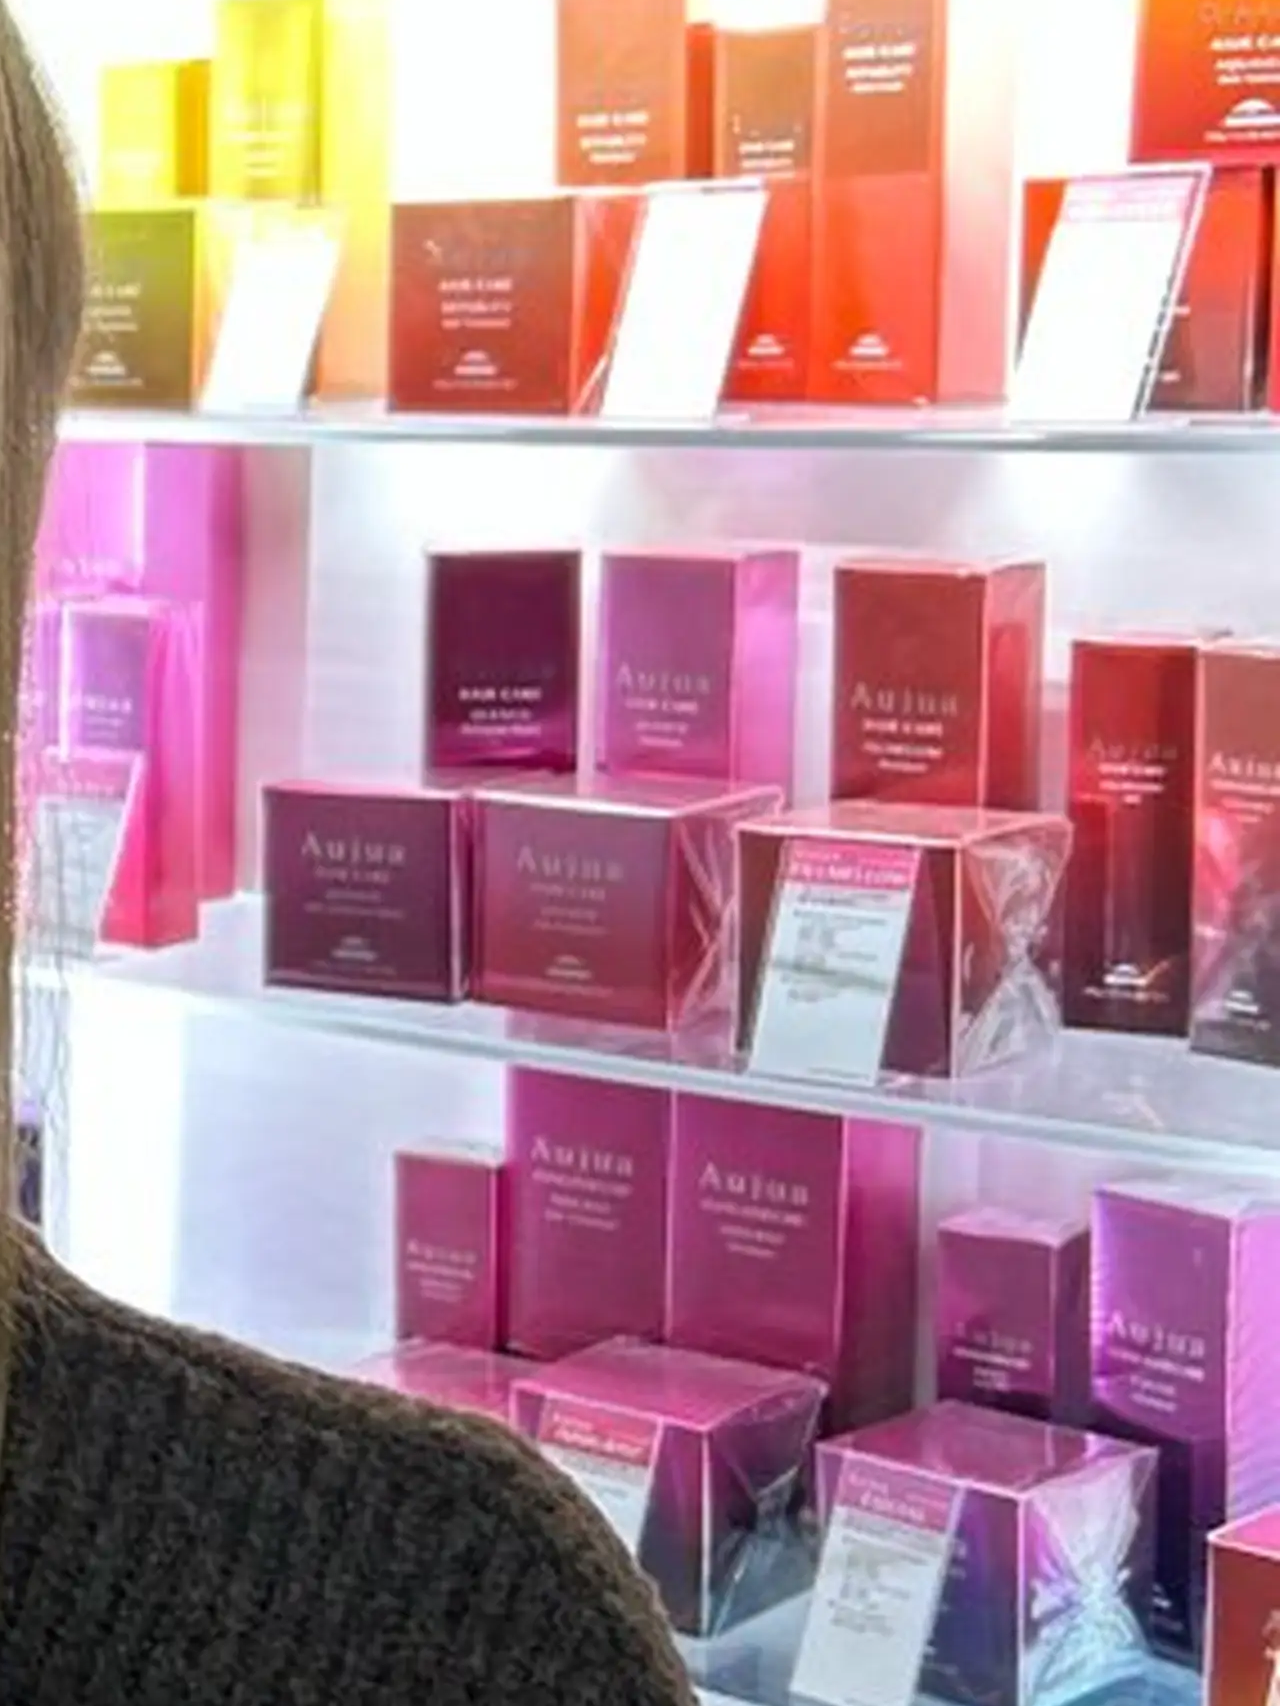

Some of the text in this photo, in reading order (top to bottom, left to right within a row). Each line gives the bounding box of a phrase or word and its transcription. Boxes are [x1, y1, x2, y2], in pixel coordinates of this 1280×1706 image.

[300, 830, 407, 866] Aujua
[530, 1135, 634, 1178] Aujua
[698, 1161, 810, 1207] Aujua
